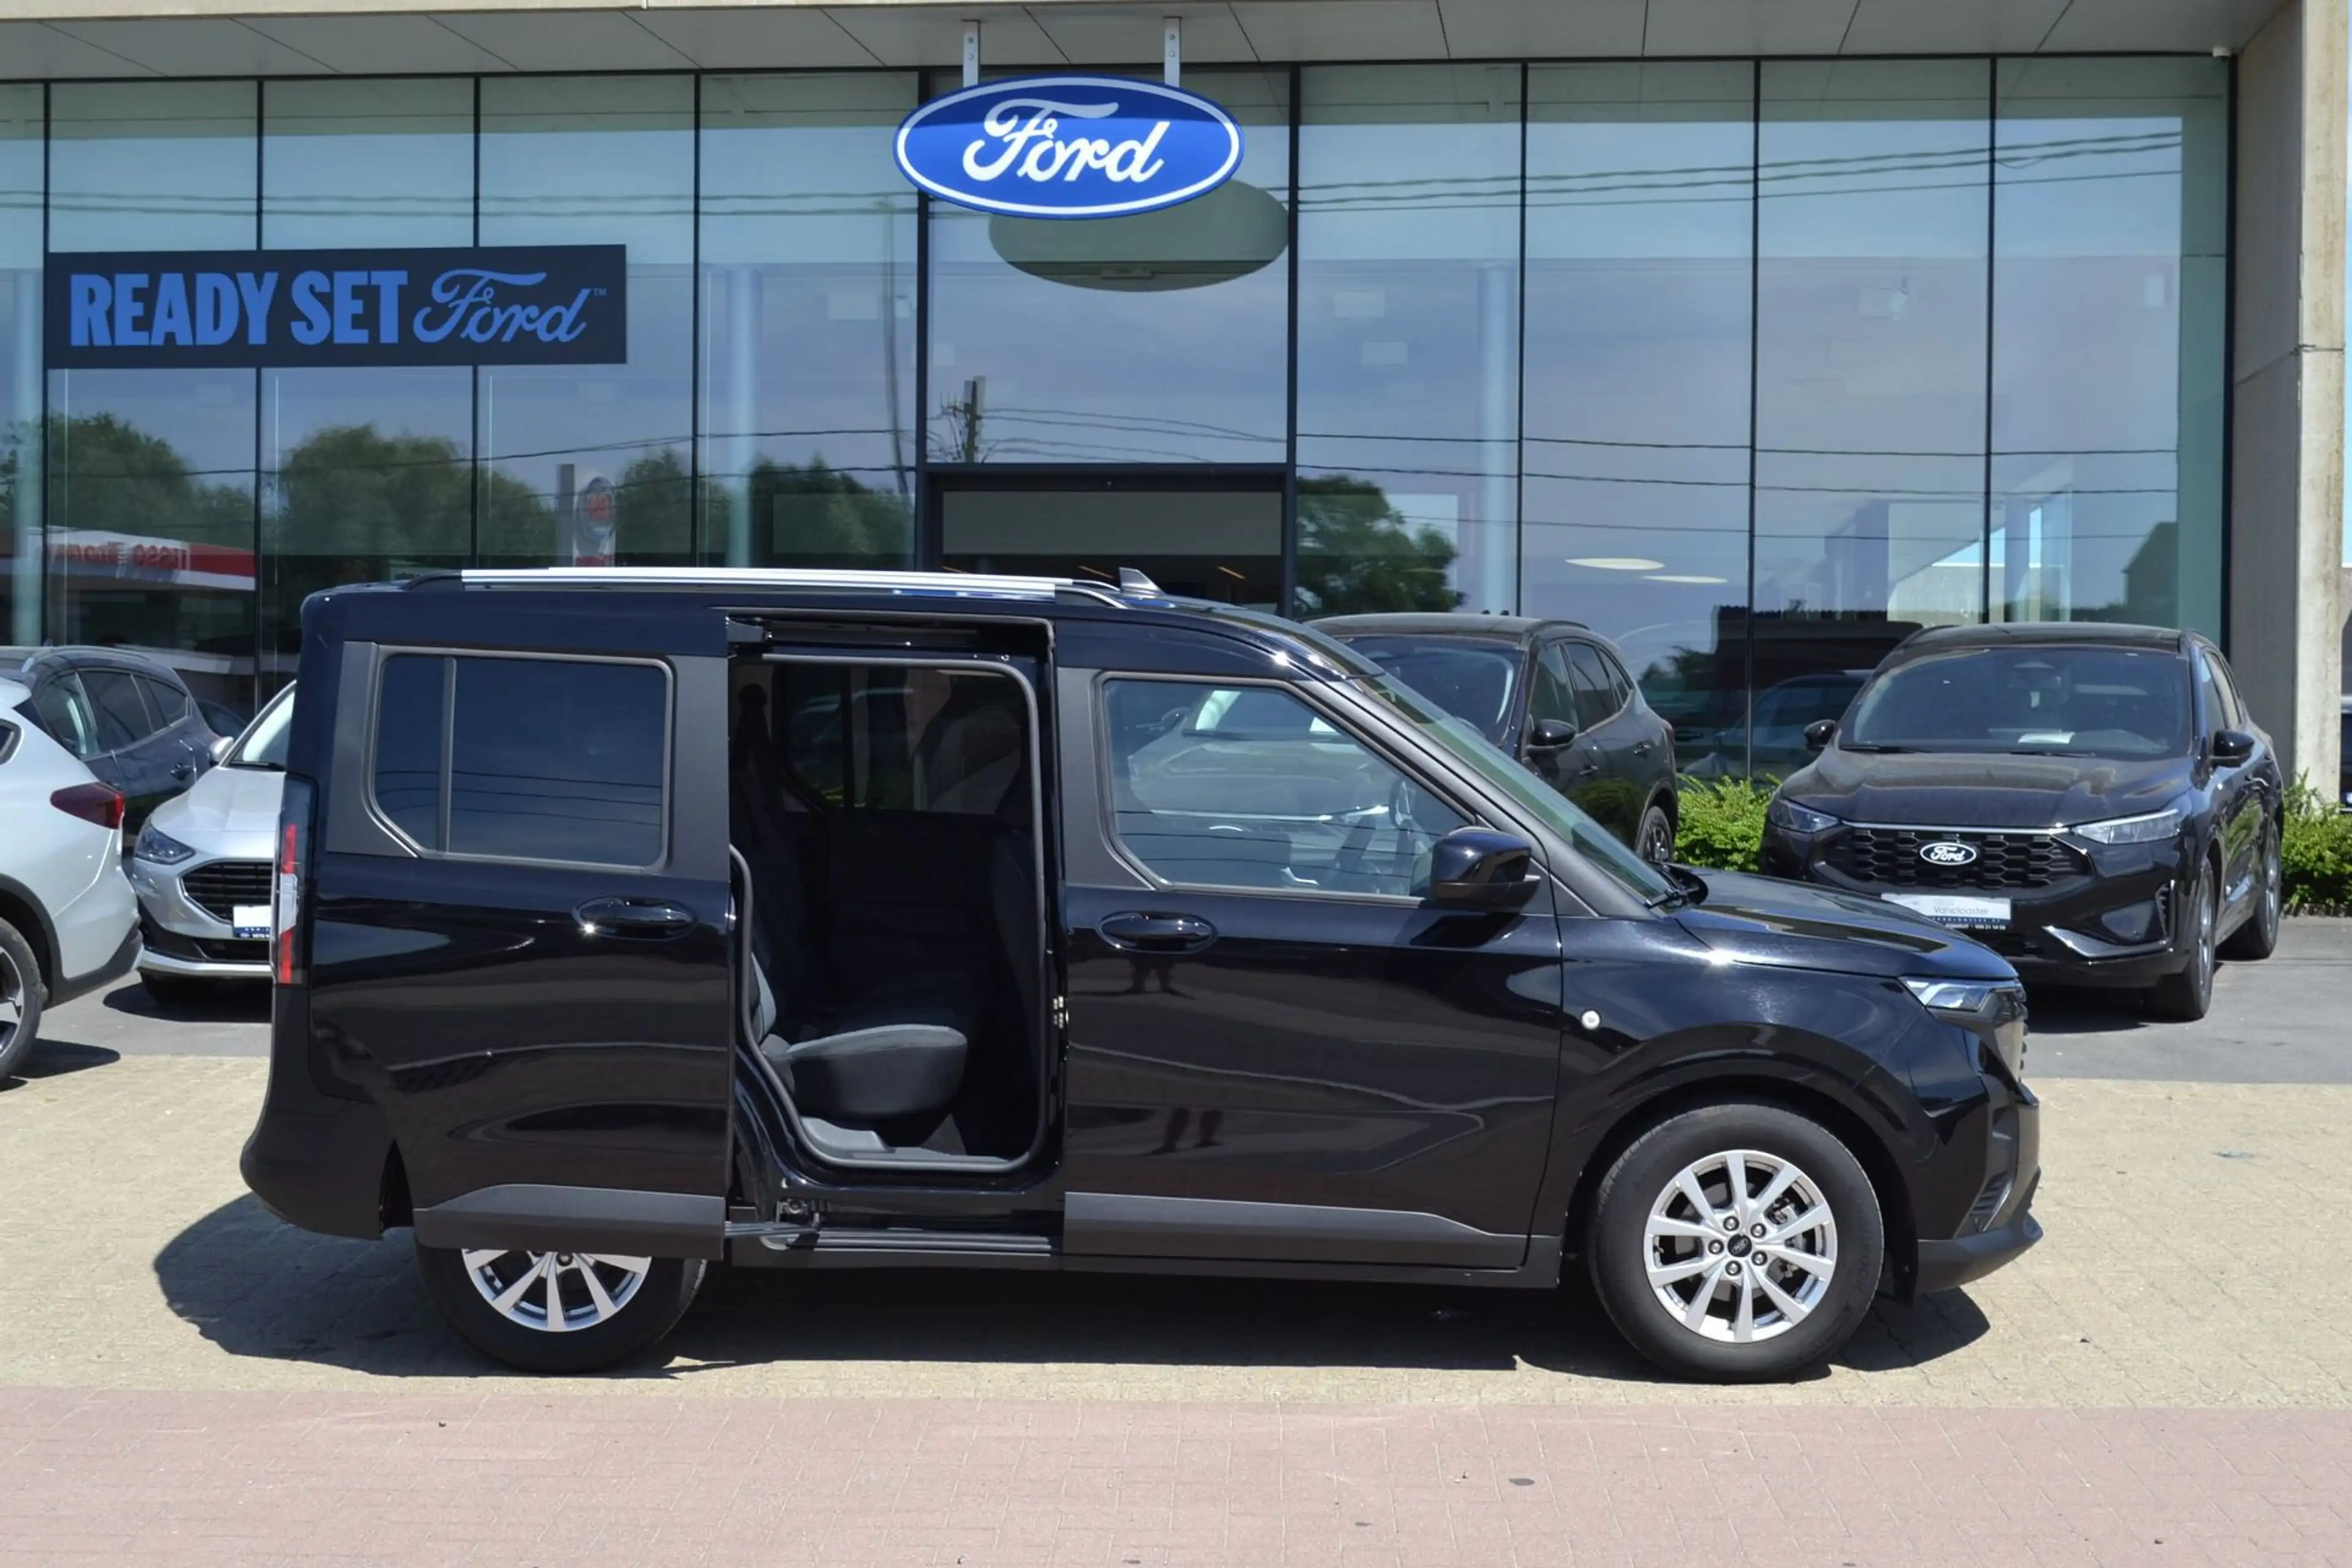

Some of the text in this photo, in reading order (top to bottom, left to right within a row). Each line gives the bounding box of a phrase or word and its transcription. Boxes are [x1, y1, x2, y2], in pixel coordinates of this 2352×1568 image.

[962, 98, 1170, 183] Ford
[70, 272, 277, 346] READY
[291, 270, 408, 345] SET
[414, 269, 591, 343] Ford
[1930, 846, 1966, 861] Ford
